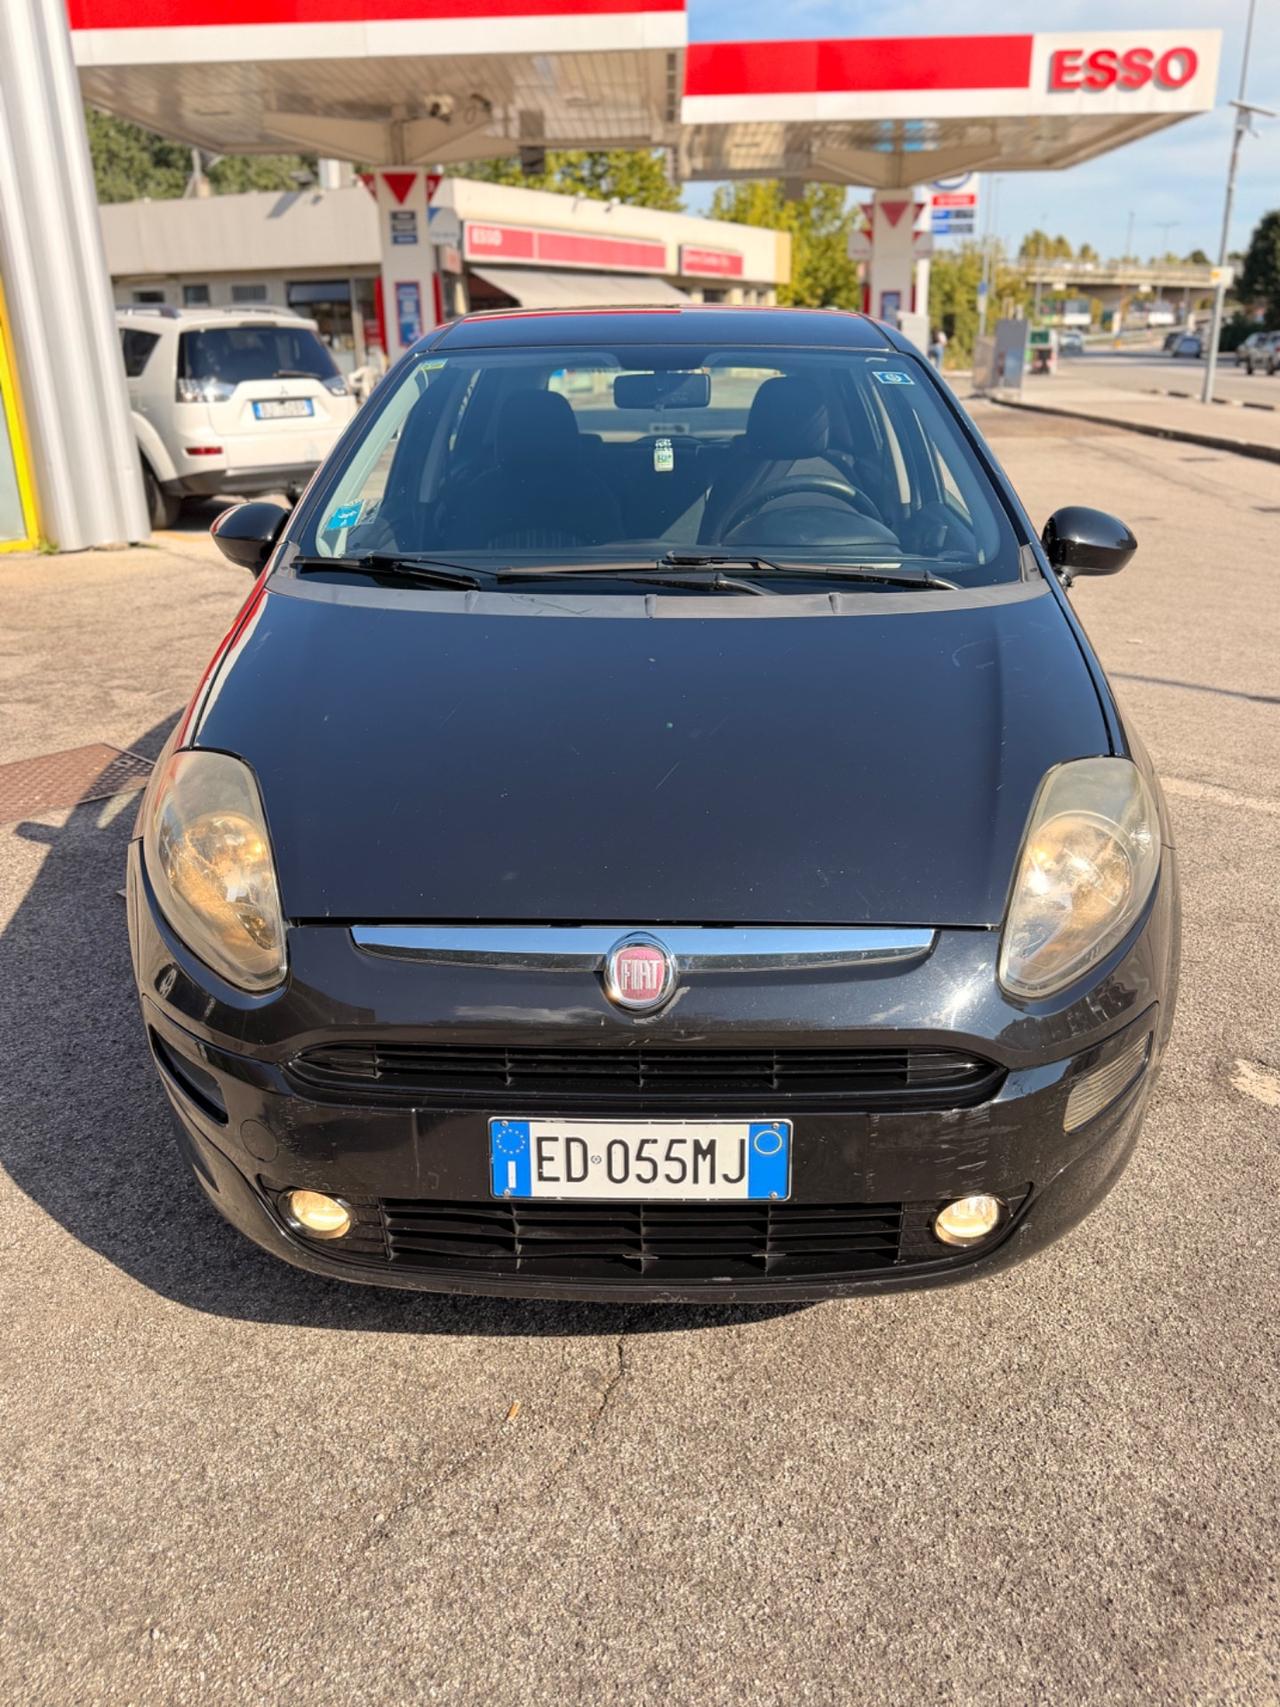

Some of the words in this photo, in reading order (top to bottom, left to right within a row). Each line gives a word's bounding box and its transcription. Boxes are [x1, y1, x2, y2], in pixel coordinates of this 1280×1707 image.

[1050, 46, 1199, 91] ESSO
[620, 959, 661, 992] FIAT
[536, 1136, 589, 1183] ED
[606, 1138, 746, 1184] 055MJ
